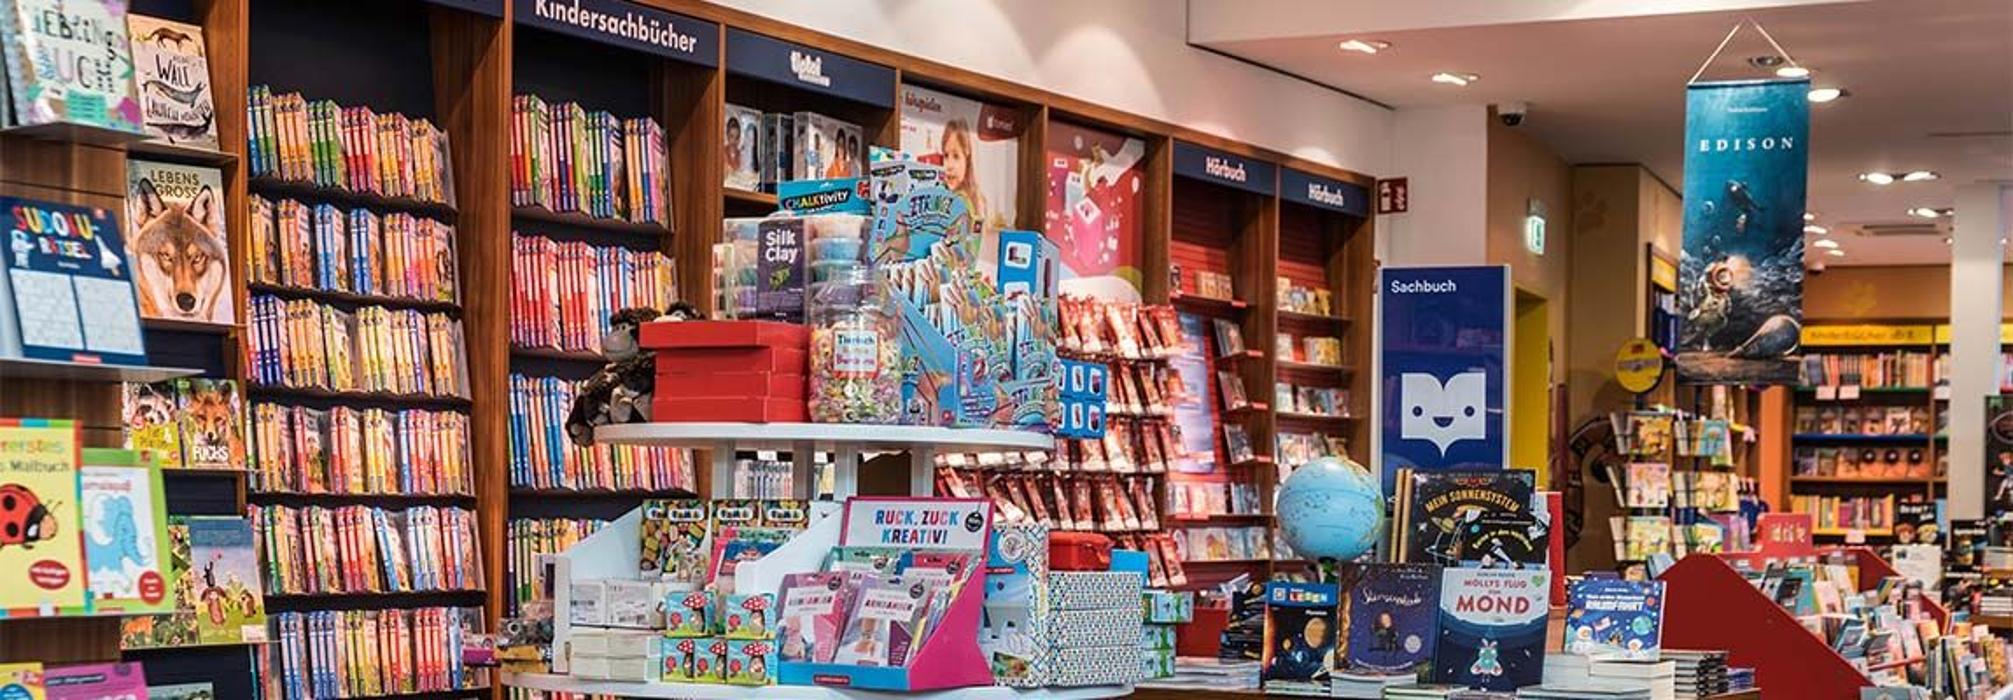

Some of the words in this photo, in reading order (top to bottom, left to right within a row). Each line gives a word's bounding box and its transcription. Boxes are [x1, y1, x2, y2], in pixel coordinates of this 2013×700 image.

[535, 0, 697, 52] Kindersachbücher
[1699, 137, 1793, 152] EDISON
[1206, 156, 1246, 182] Hörbuch
[151, 169, 199, 186] LEBENS
[1308, 183, 1344, 207] Hörbuch
[766, 229, 795, 246] Silk
[765, 247, 797, 263] Clay
[1391, 280, 1456, 293] Sachbuch
[922, 510, 959, 525] ZUCK
[882, 529, 948, 544] KREATIV!
[1464, 579, 1500, 588] MOLLYS
[1504, 579, 1528, 588] FLUG
[1456, 595, 1530, 614] MOND
